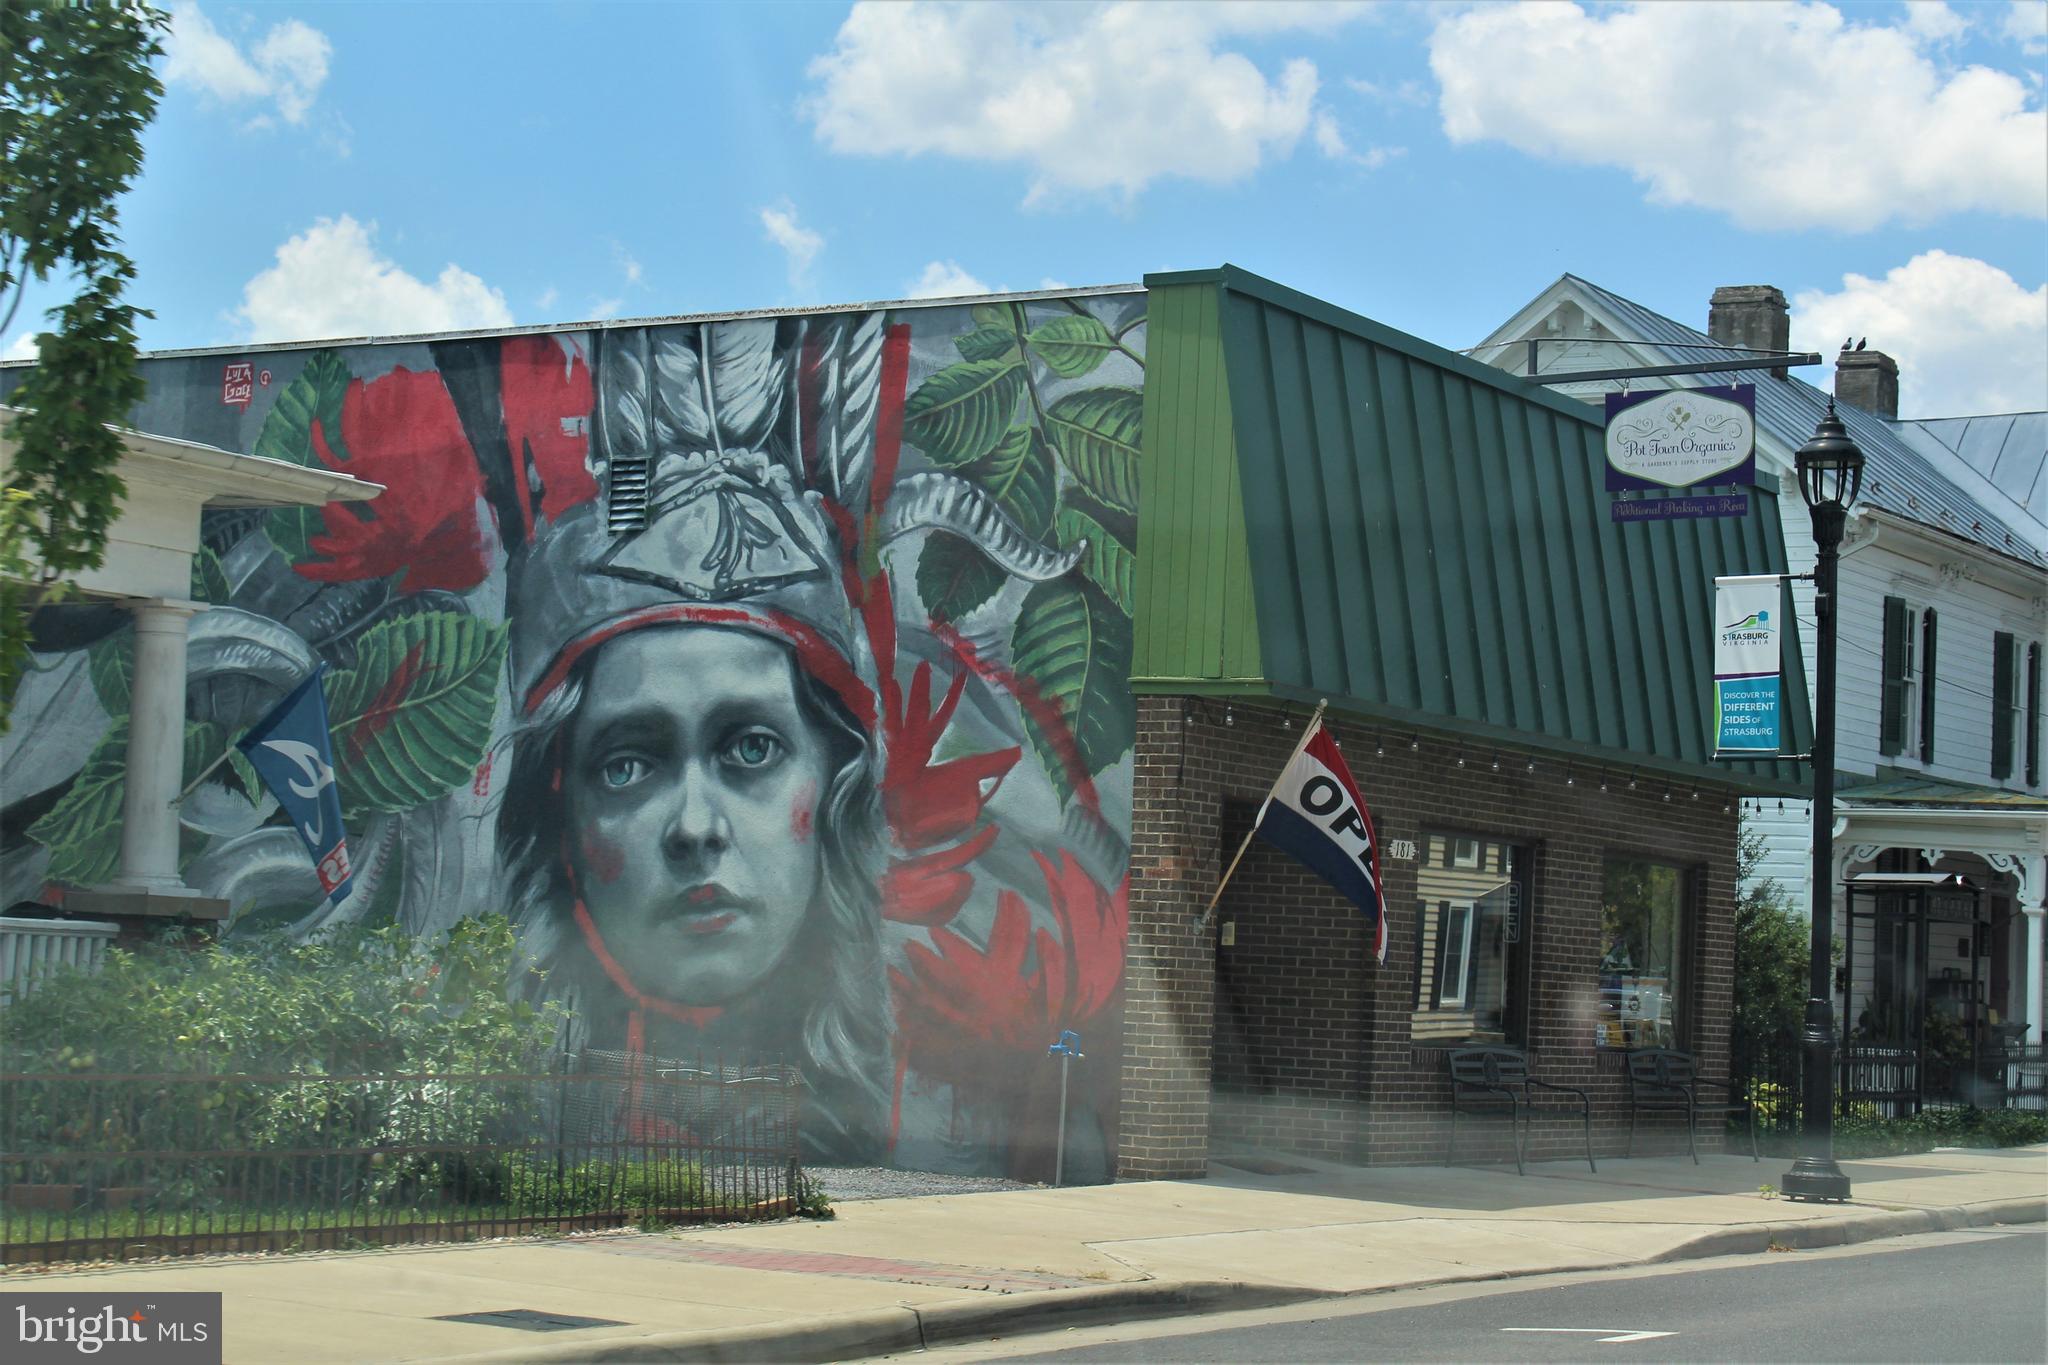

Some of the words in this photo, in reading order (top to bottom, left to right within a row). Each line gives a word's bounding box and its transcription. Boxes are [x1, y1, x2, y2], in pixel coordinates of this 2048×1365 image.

[1624, 440, 1647, 457] Pot
[1649, 439, 1680, 456] Town
[1681, 437, 1735, 457] Organics
[1706, 501, 1716, 512] in
[1722, 632, 1769, 641] STRASBURG
[1724, 691, 1759, 699] DISCOVER
[1724, 702, 1775, 712] DIFFERENT
[1724, 715, 1751, 724] SIDES
[1724, 727, 1773, 736] STRASBURG
[1395, 842, 1411, 858] 181
